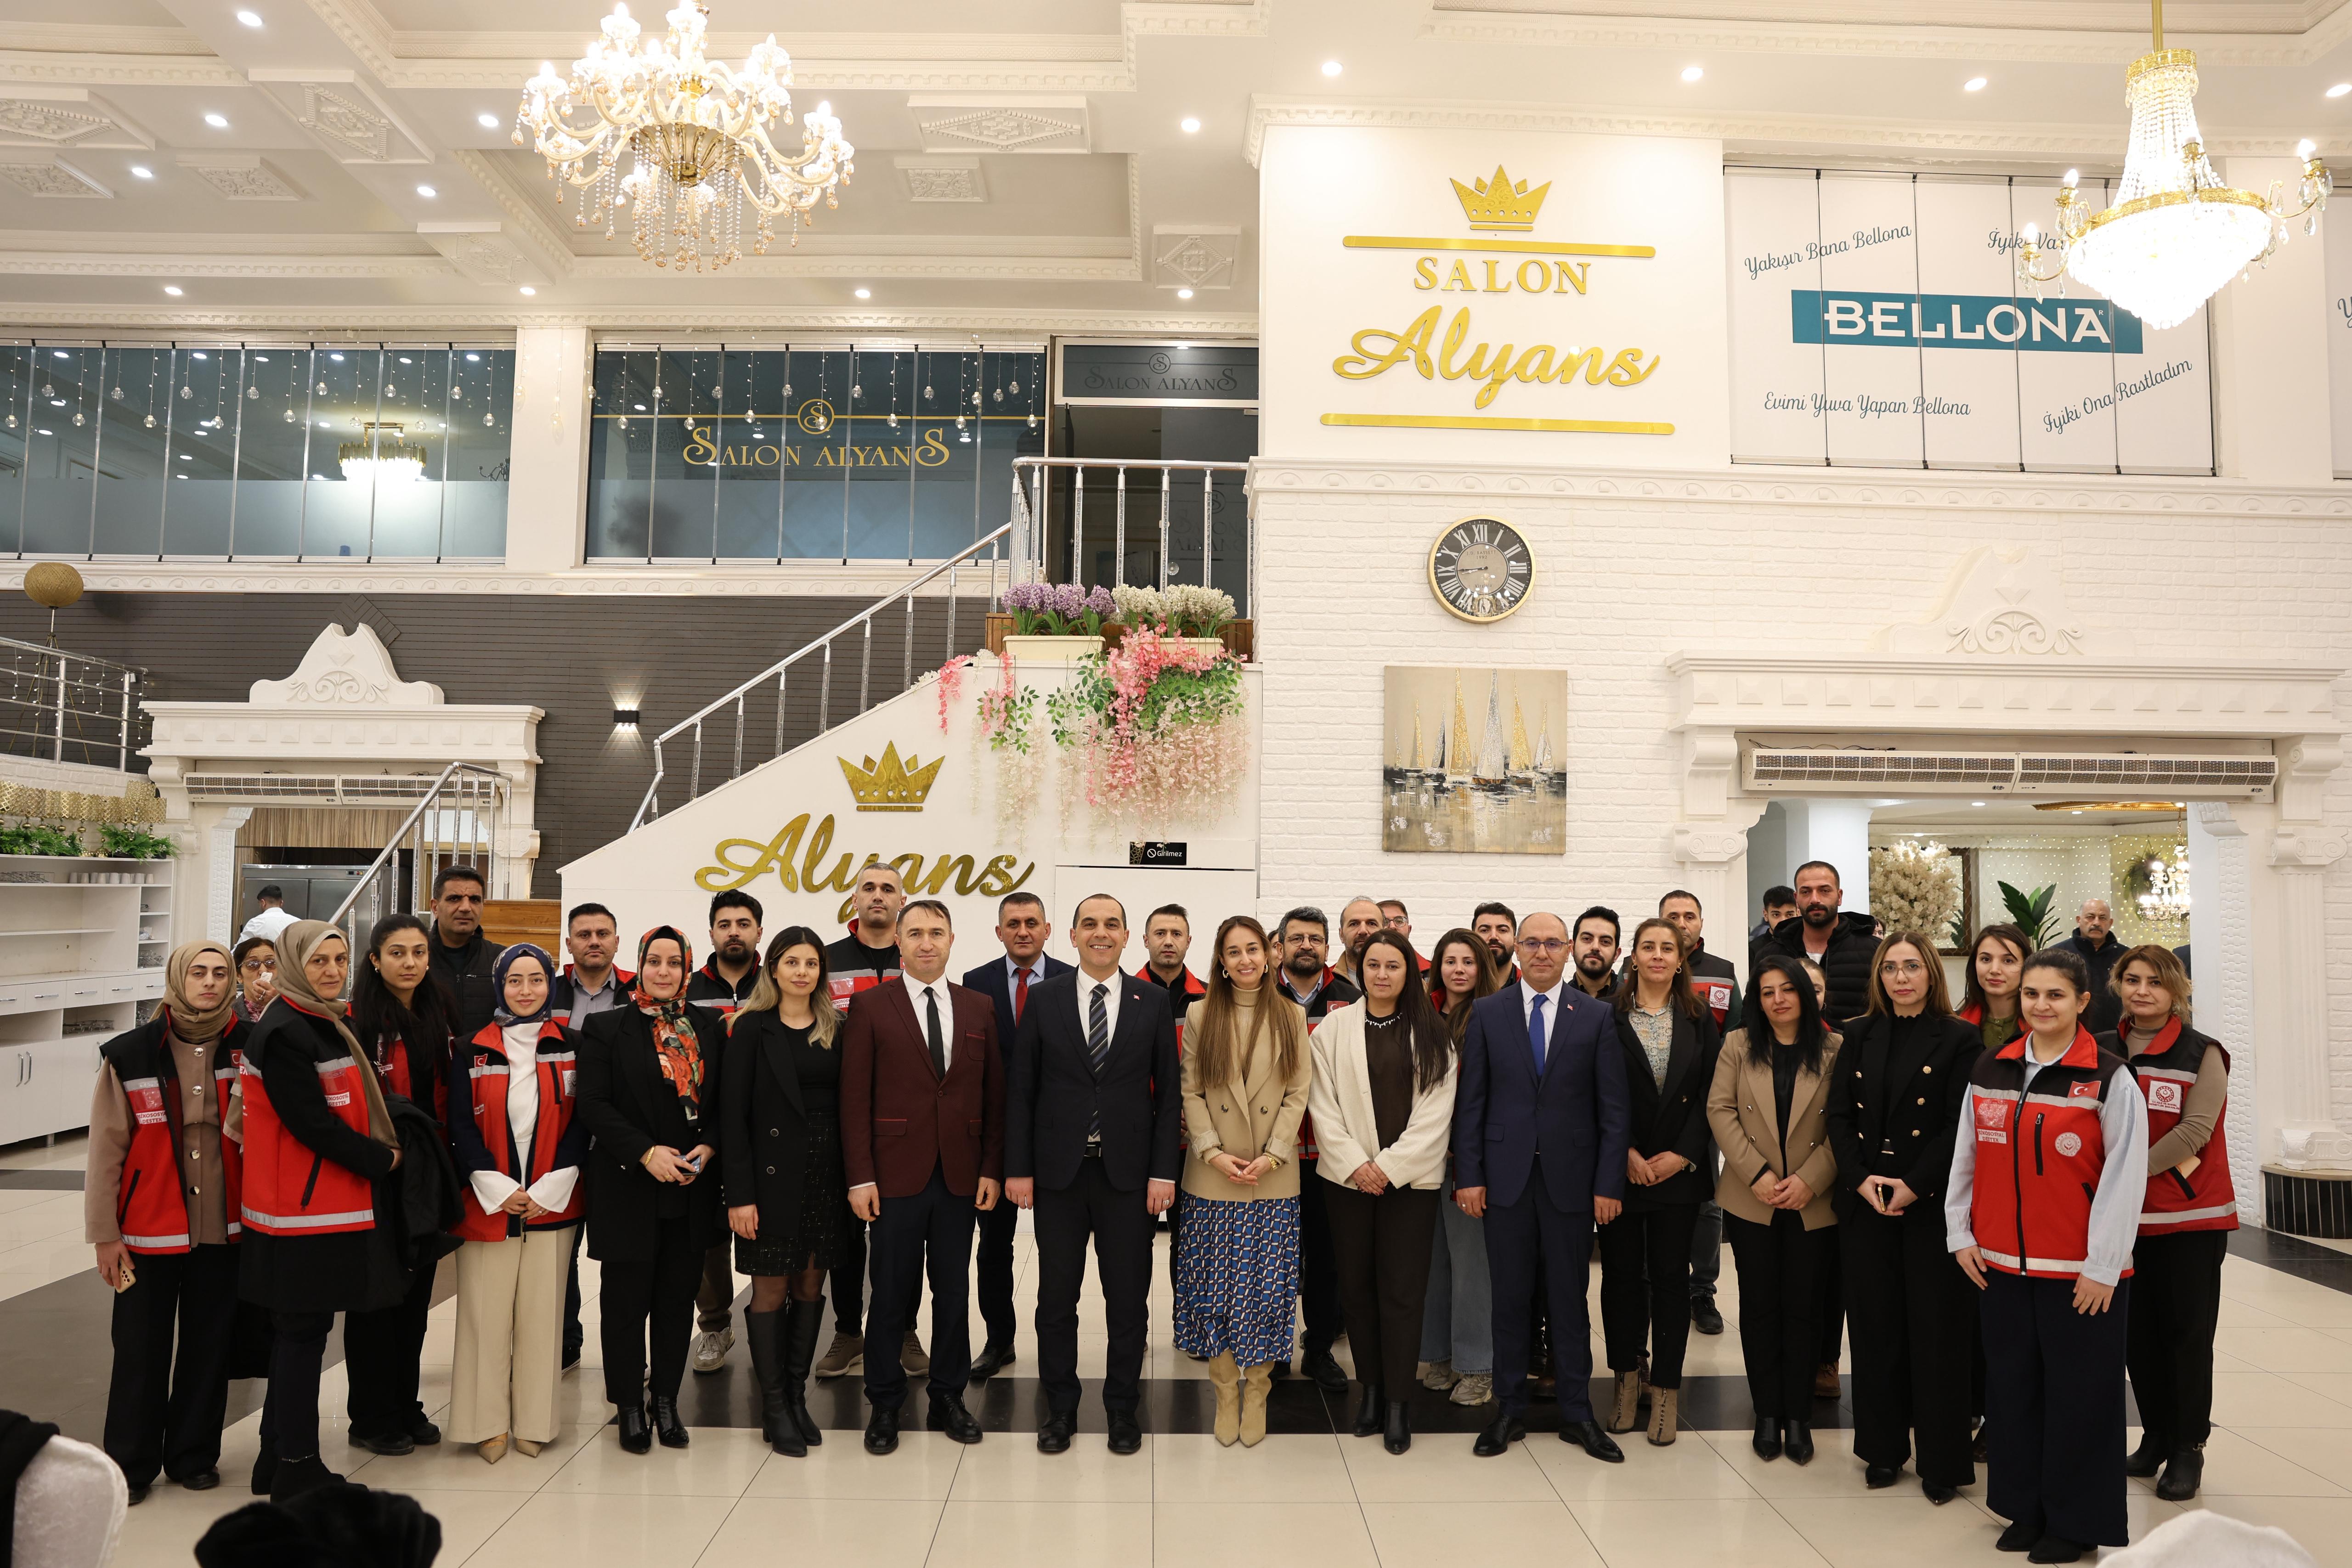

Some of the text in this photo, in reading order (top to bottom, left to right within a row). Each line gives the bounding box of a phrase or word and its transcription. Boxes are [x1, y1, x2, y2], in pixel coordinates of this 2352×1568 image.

[1744, 225, 1912, 280] Yakışır Bana Bellona
[1988, 228, 2026, 255] İyik
[1413, 256, 1591, 295] SALON
[1824, 300, 2110, 343] BELLONA
[1084, 366, 1238, 391] SALON ALYANS
[1332, 305, 1660, 410] Alyans
[1764, 391, 1971, 419] Evimi Yuva Yapan Bellona
[2043, 359, 2193, 435] İyiki Ona Rastladım
[683, 426, 950, 467] SALON ALYANS
[694, 813, 1035, 925] Alyans
